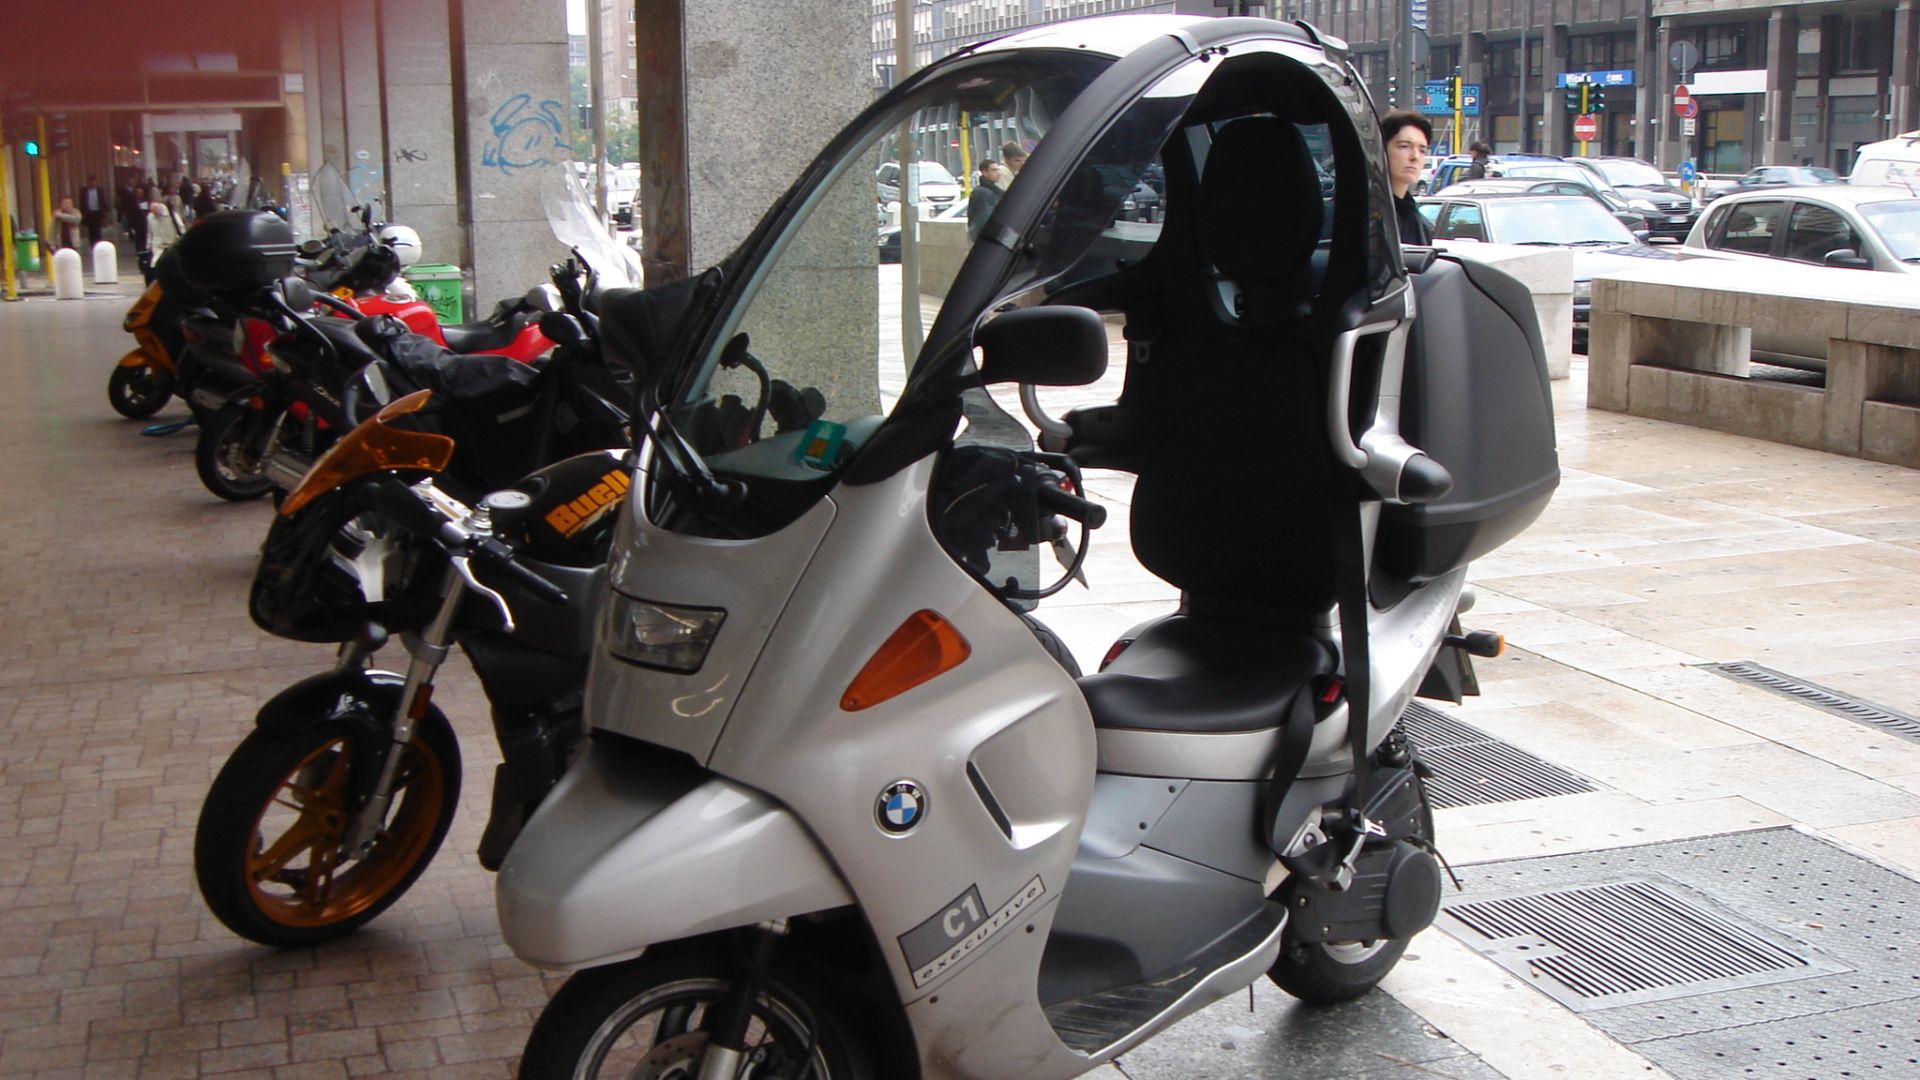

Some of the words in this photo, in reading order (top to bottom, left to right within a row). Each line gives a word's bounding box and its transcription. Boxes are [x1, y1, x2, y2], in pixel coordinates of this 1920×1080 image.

[1464, 96, 1476, 106] P
[544, 469, 631, 534] Buell
[882, 785, 922, 802] BMW
[943, 895, 980, 937] C1
